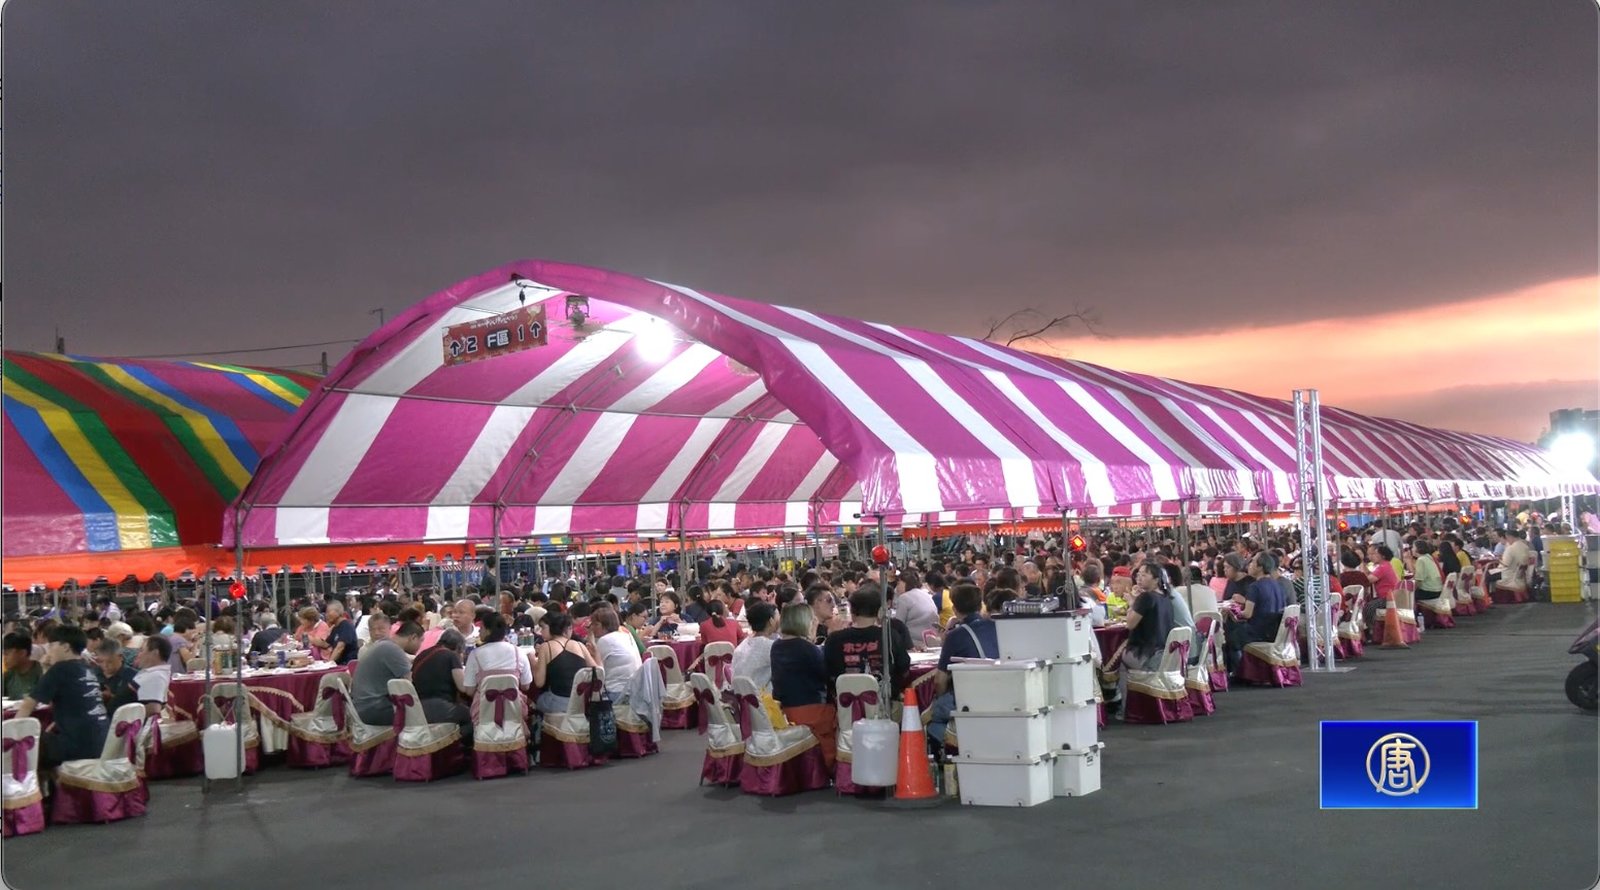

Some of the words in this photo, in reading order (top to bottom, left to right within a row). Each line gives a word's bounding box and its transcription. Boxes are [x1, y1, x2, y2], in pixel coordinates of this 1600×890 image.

[467, 336, 478, 353] 2
[487, 329, 509, 348] F區
[517, 324, 525, 342] 1
[843, 641, 879, 653] ホンダ
